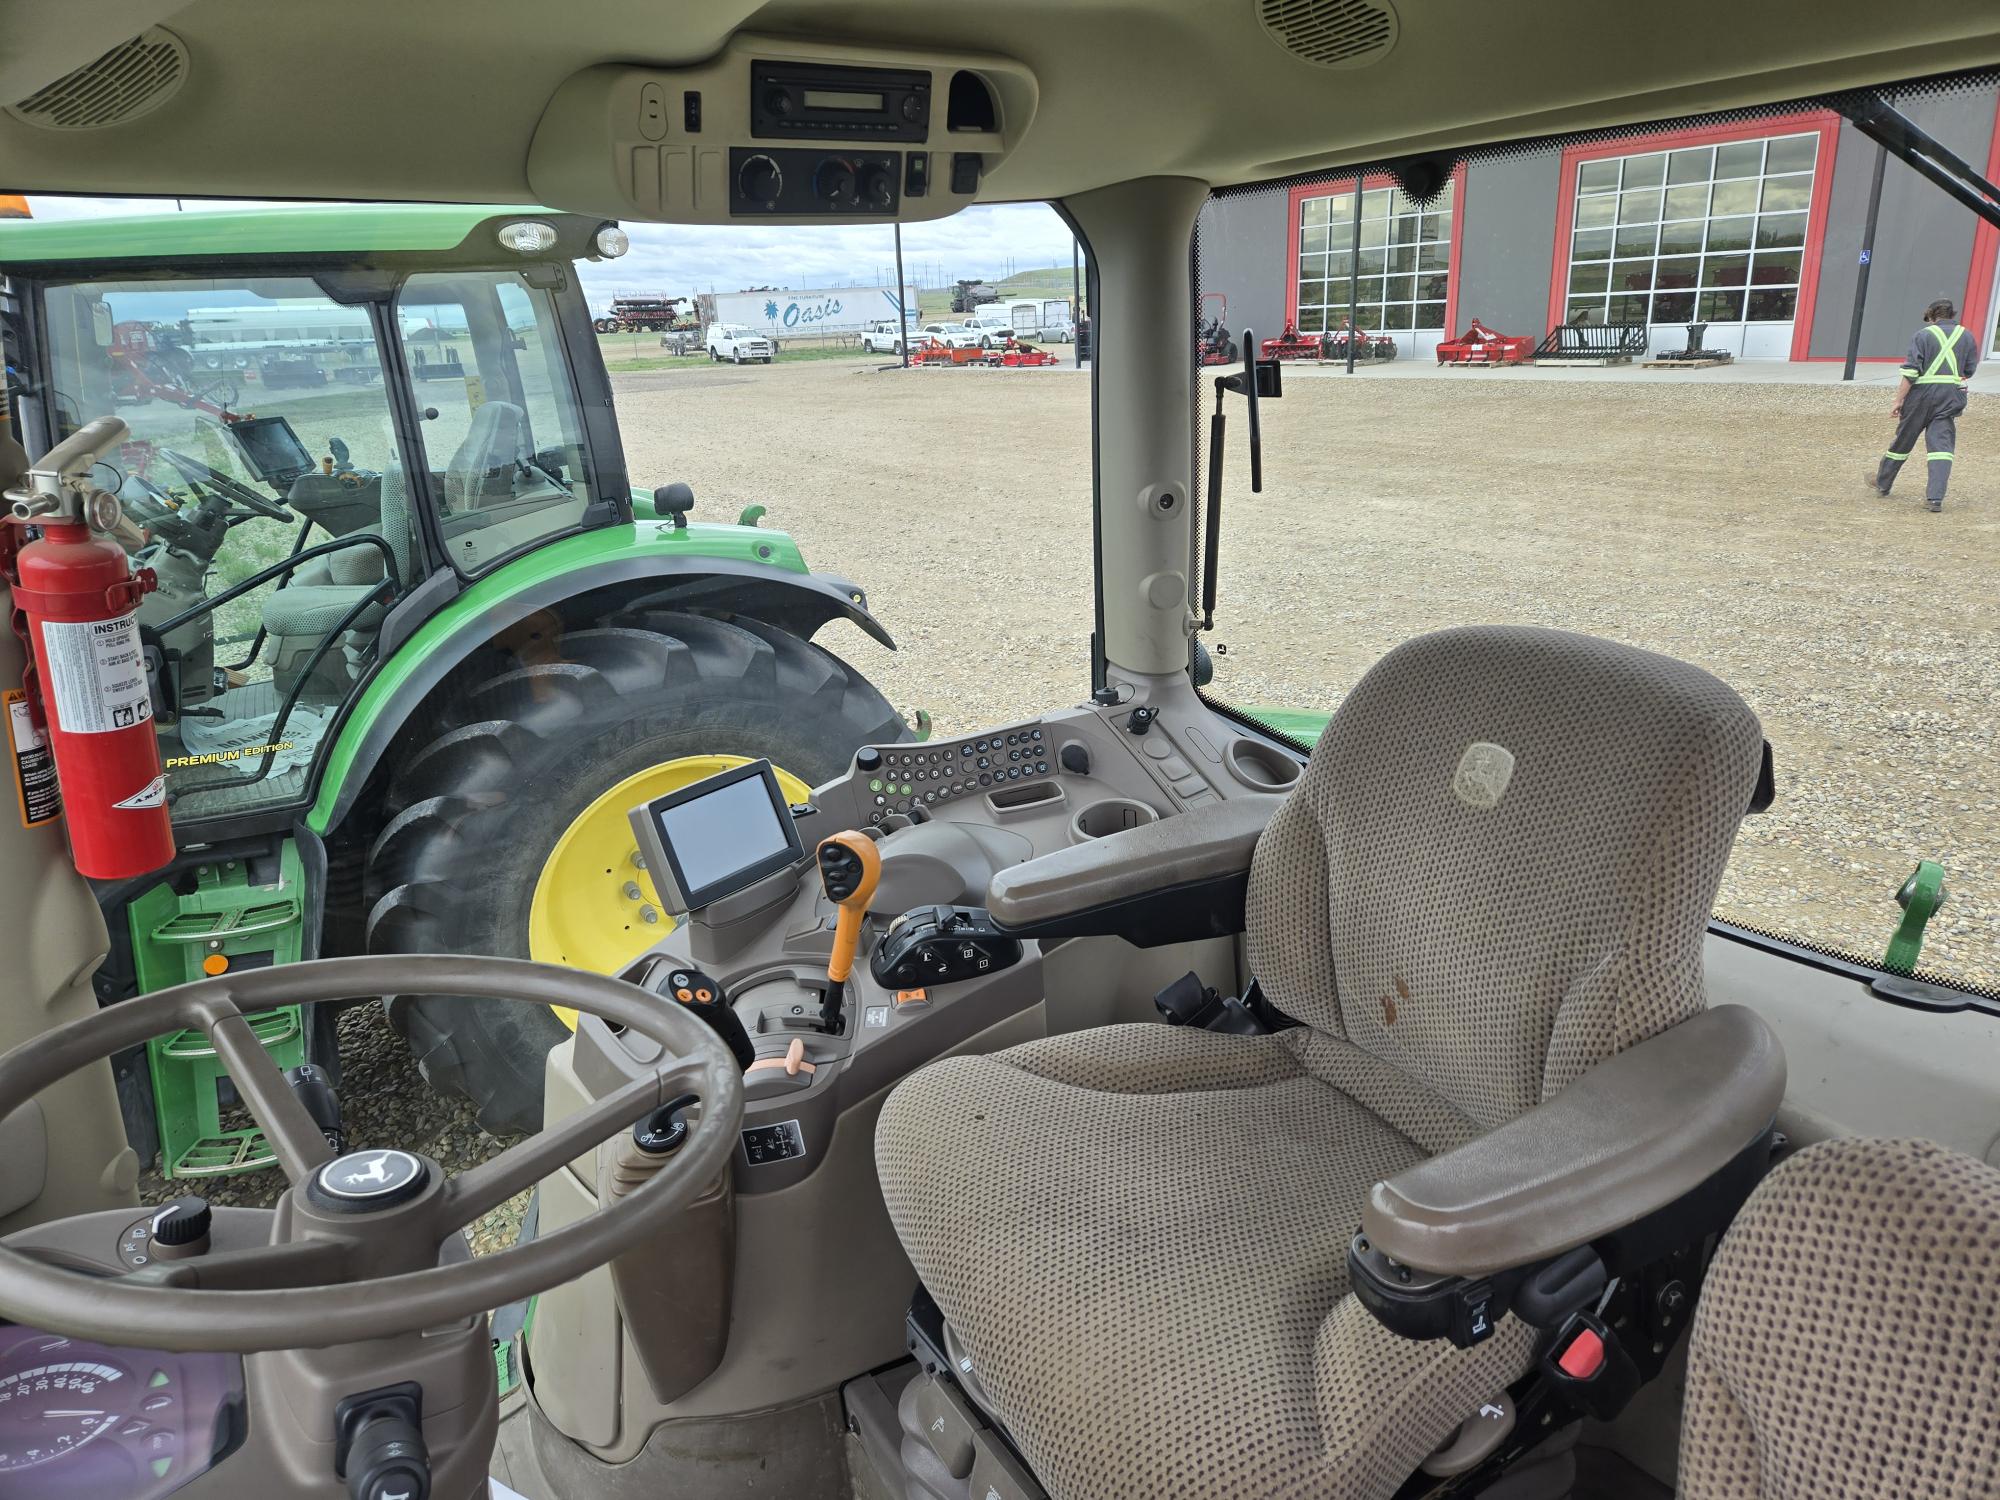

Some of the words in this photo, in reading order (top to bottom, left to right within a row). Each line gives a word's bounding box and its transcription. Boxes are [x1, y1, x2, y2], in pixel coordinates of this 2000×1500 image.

[783, 298, 843, 328] Oasis
[166, 750, 240, 769] PREMIUM
[244, 741, 294, 757] EDITION
[889, 755, 895, 763] F
[17, 1384, 30, 1396] 20
[35, 1379, 48, 1391] 30
[54, 1377, 67, 1389] 40
[69, 1377, 82, 1390] 50
[81, 1381, 95, 1394] 60
